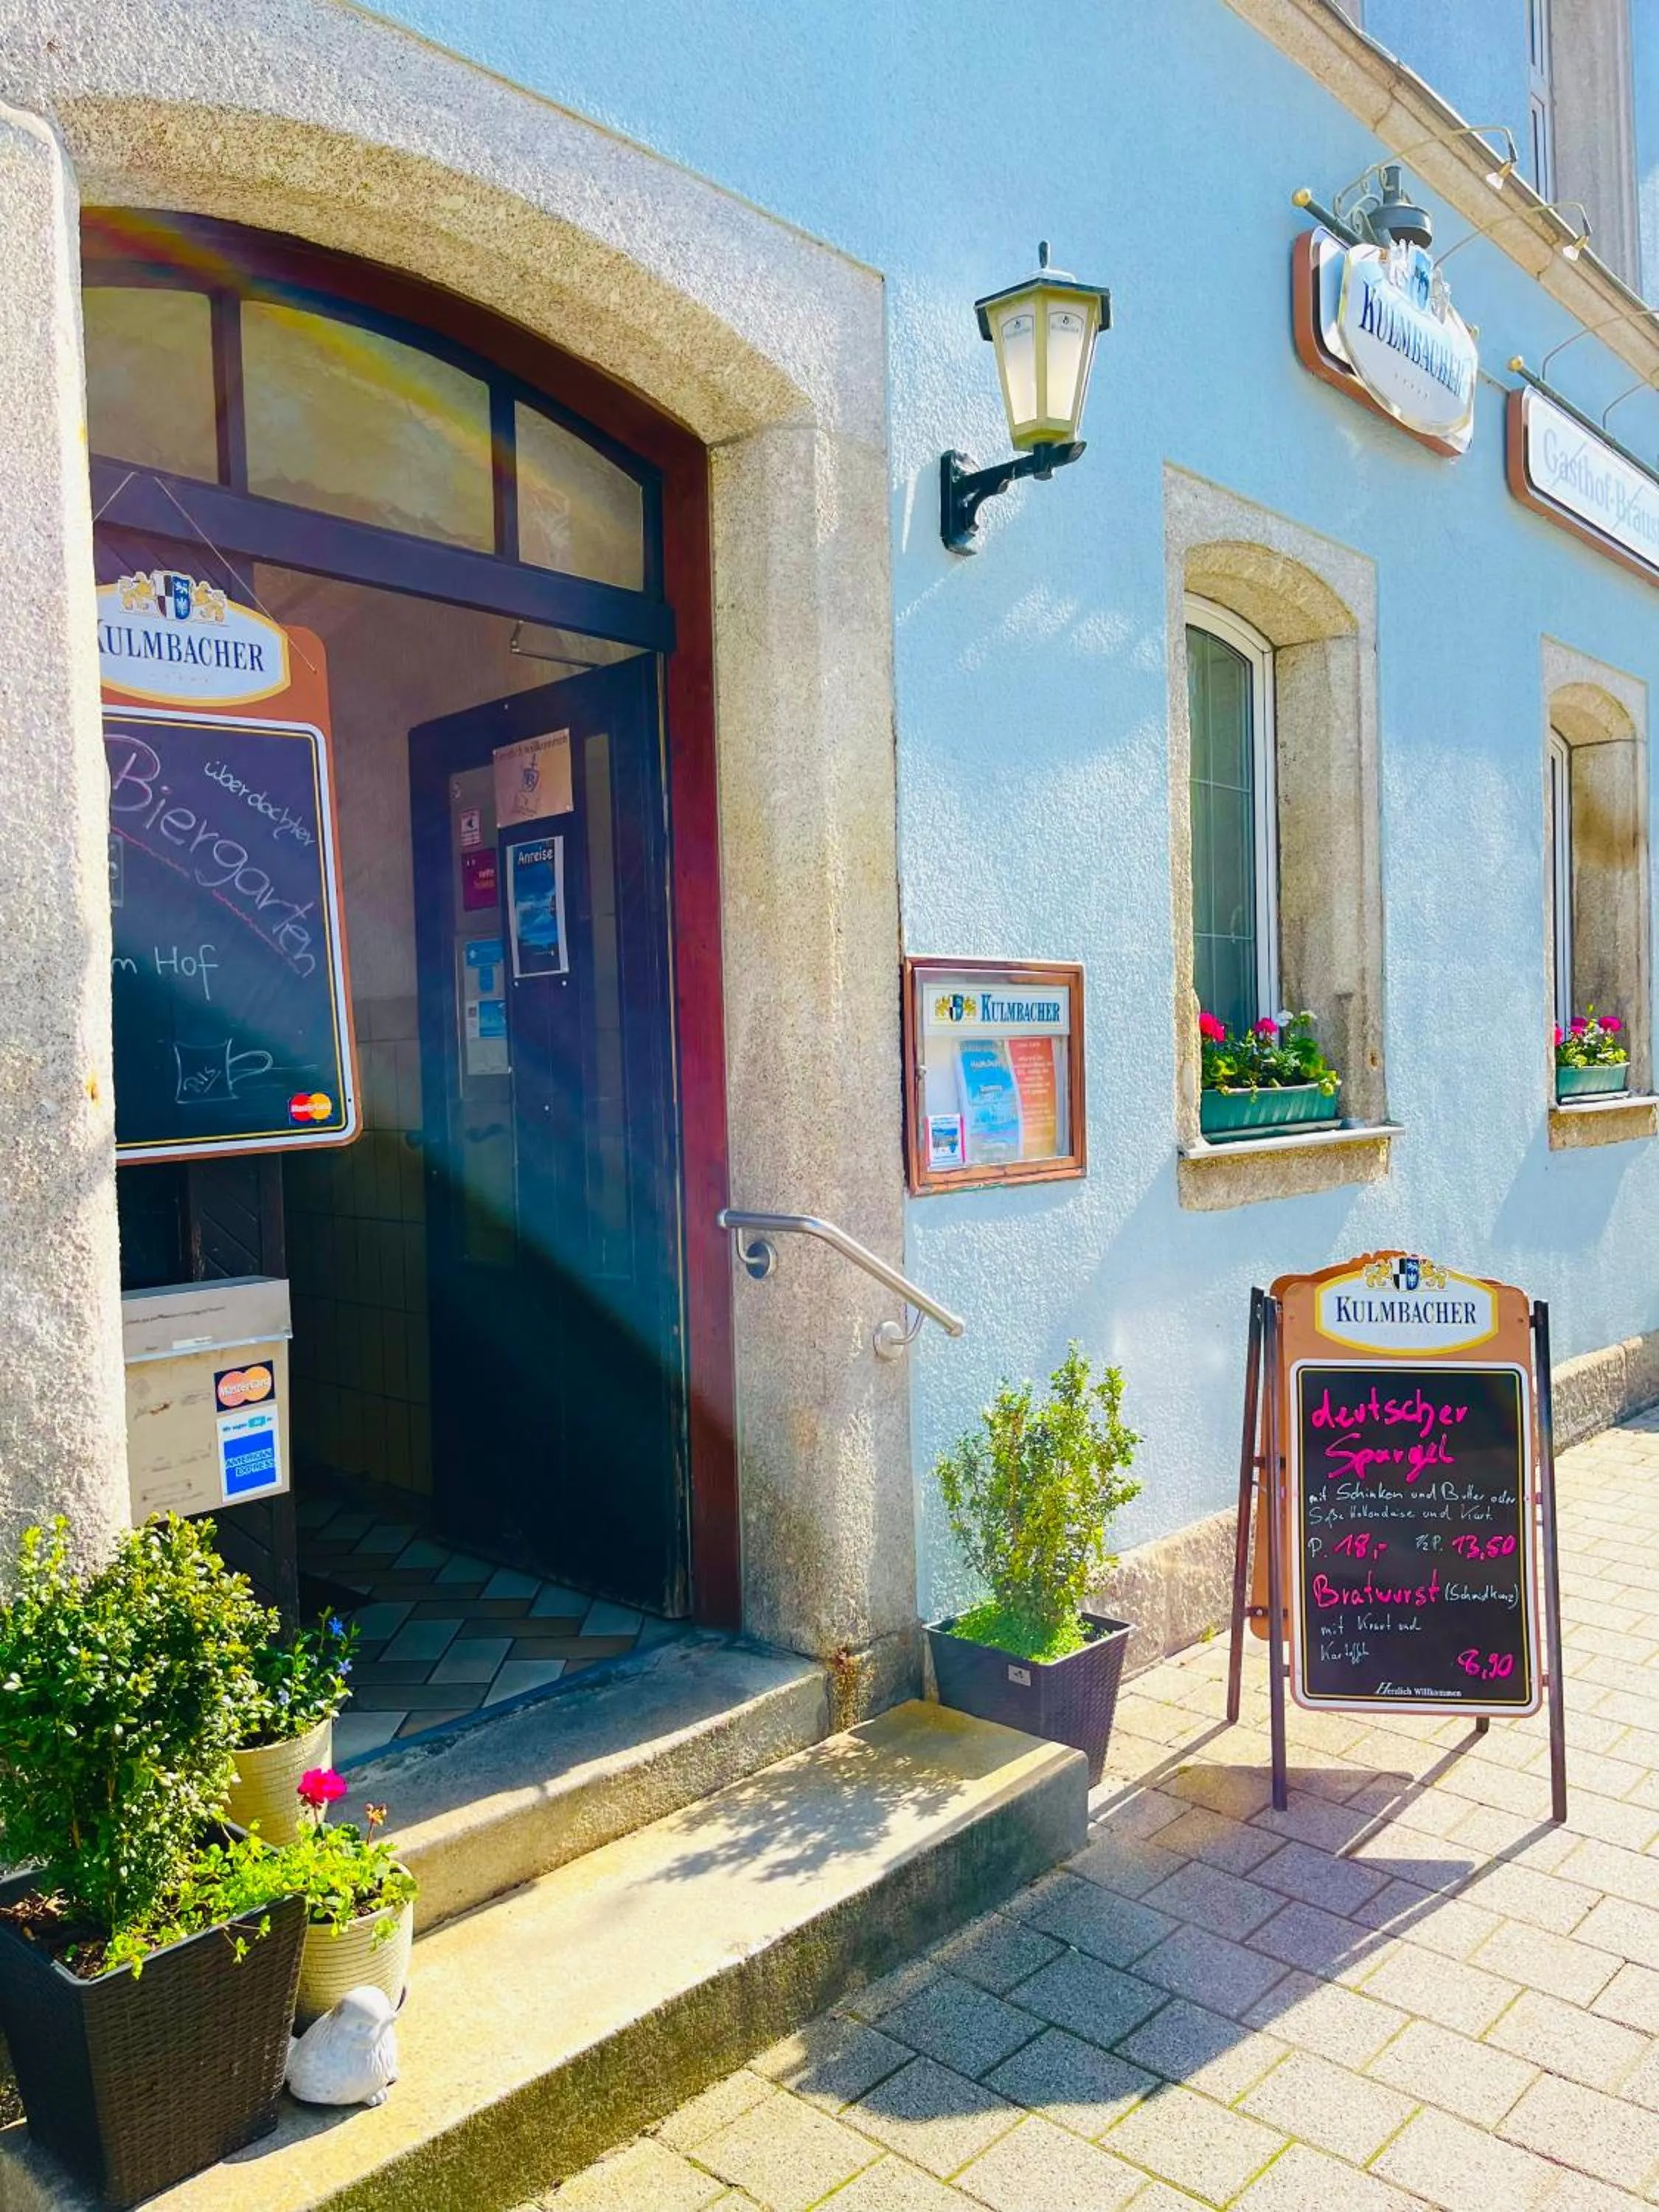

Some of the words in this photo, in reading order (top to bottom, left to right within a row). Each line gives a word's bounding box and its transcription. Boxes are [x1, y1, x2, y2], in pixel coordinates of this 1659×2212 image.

[103, 734, 316, 978] Biergarten
[518, 846, 554, 866] Anreise
[154, 945, 219, 1001] Hof
[981, 994, 1060, 1023] KULMBACHER
[1335, 1295, 1476, 1324] KULMBACHER
[1312, 1385, 1468, 1438] deutscher
[1324, 1433, 1455, 1482] Spargel
[1309, 1485, 1328, 1504] mit
[1336, 1482, 1403, 1501] Schinken
[1411, 1483, 1437, 1500] und
[1441, 1481, 1484, 1501] Butter
[1490, 1489, 1517, 1505] oder
[1422, 1505, 1452, 1520] und
[1452, 1534, 1517, 1561] 13,50
[1313, 1569, 1440, 1607] Bratwurst
[1321, 1615, 1344, 1636] mit
[1374, 1681, 1412, 1696] Herzlich
[1413, 1686, 1462, 1697] Willkommen
